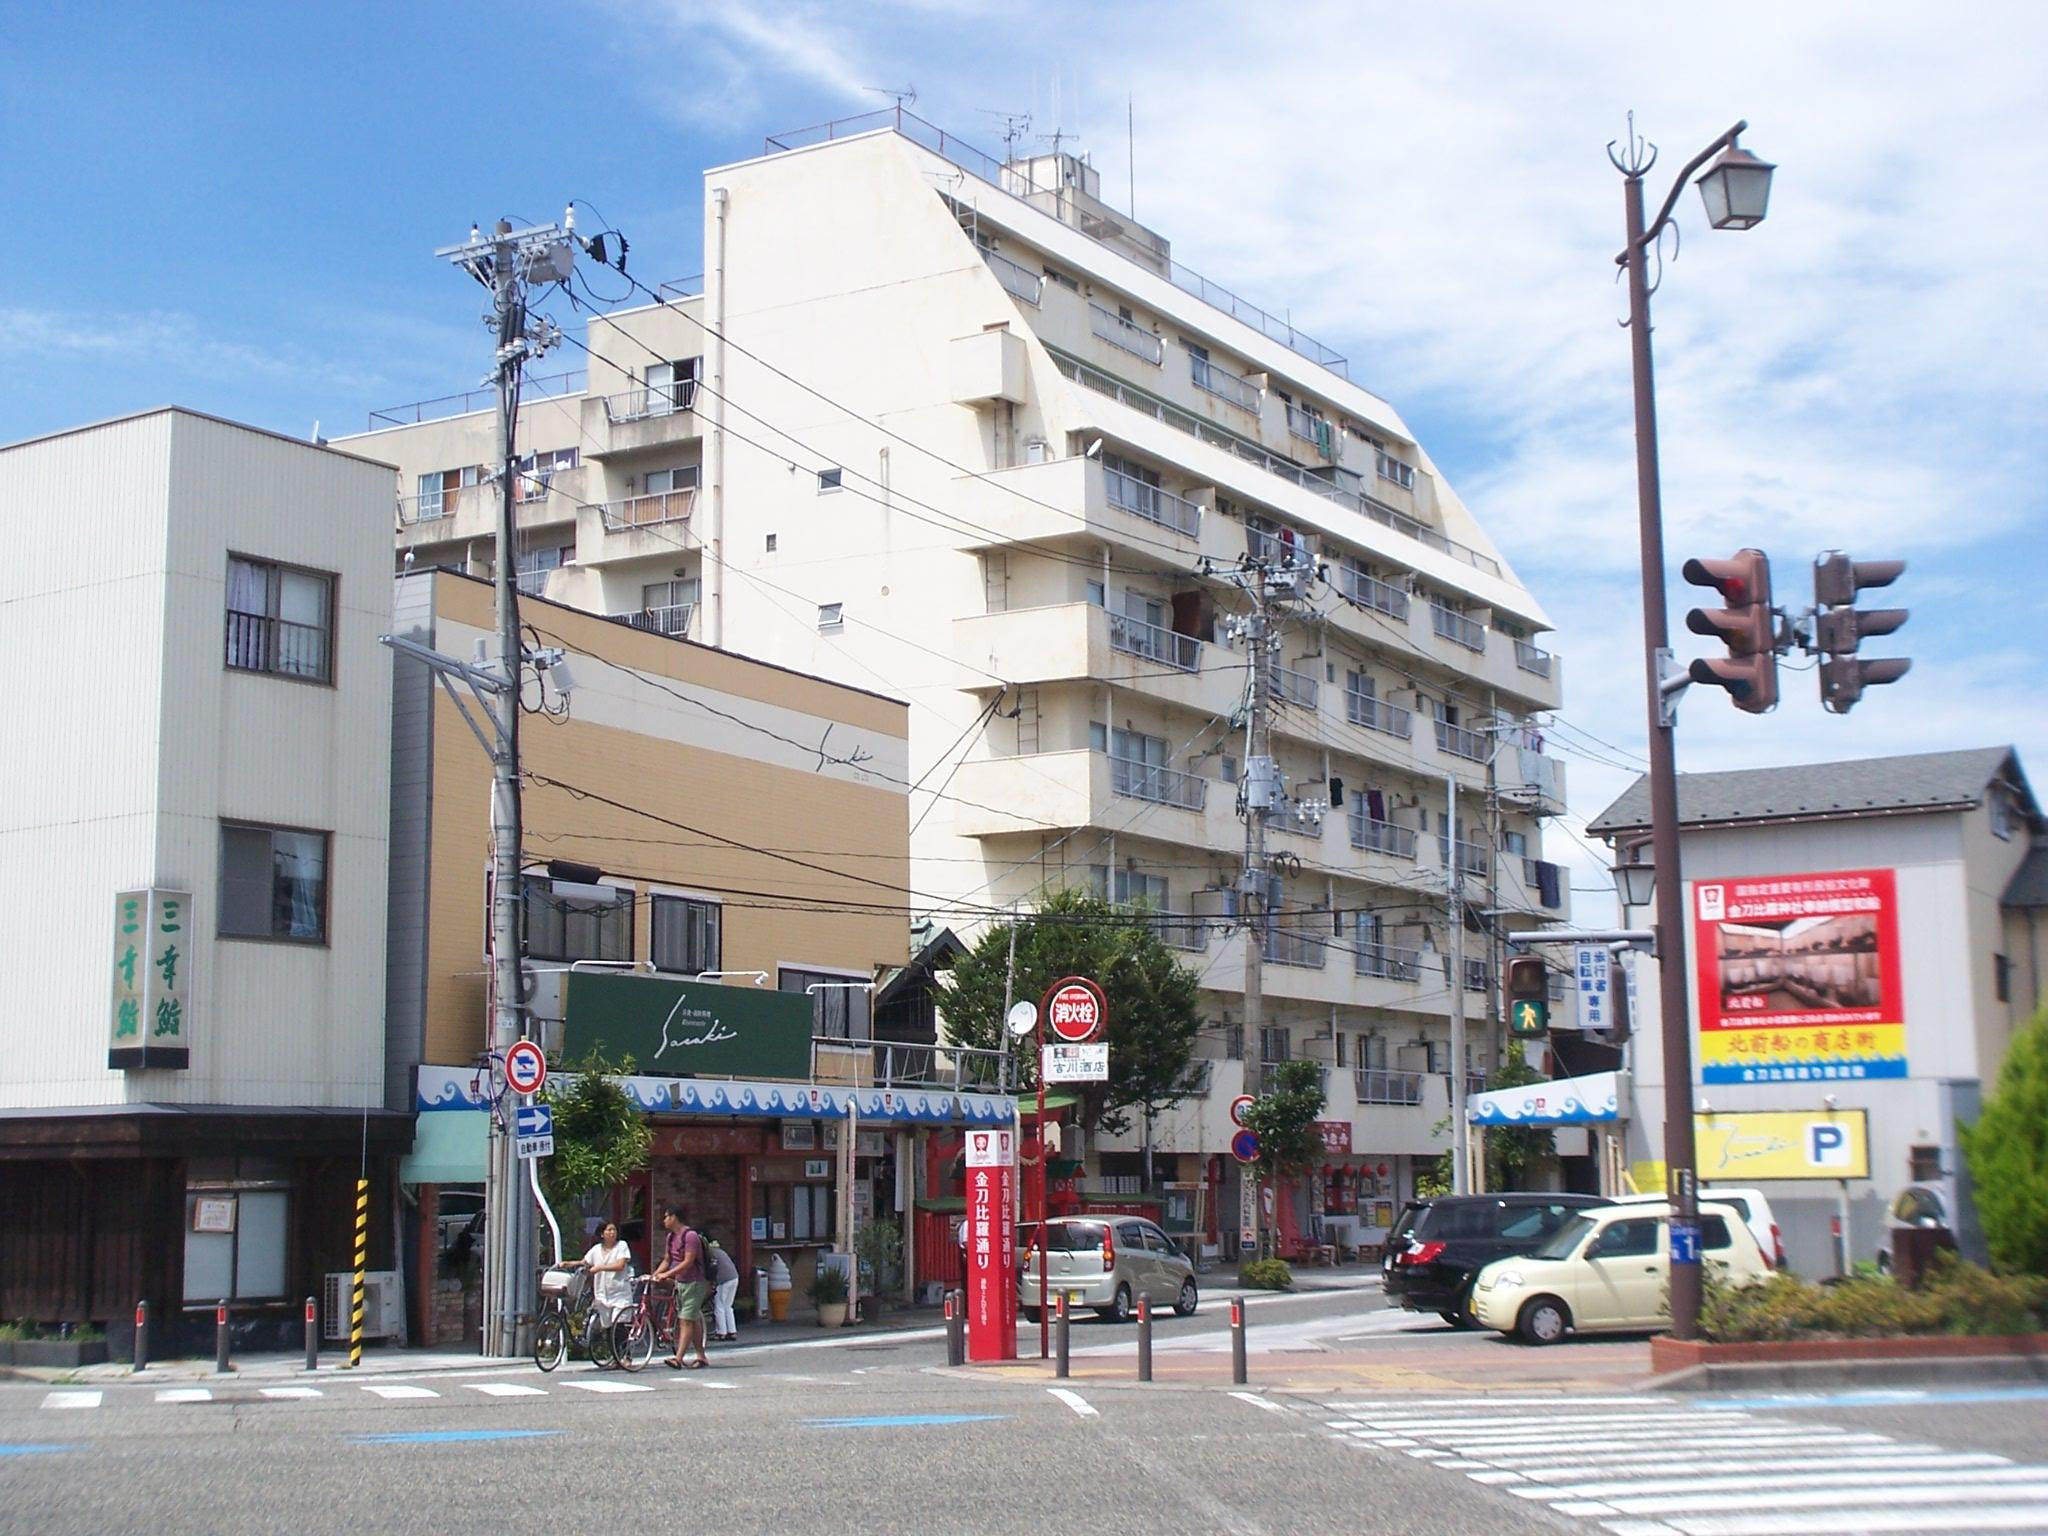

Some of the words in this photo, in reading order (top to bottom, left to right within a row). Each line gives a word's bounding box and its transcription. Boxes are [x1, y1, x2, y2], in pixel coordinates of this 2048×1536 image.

[1579, 951, 1593, 992] 自転車
[1055, 1002, 1094, 1024] 消火栓
[1588, 995, 1602, 1022] 専用
[1812, 1126, 1843, 1162] P
[974, 1170, 990, 1270] 金刀比羅通り
[1001, 1170, 1011, 1269] 金刀比羅通り
